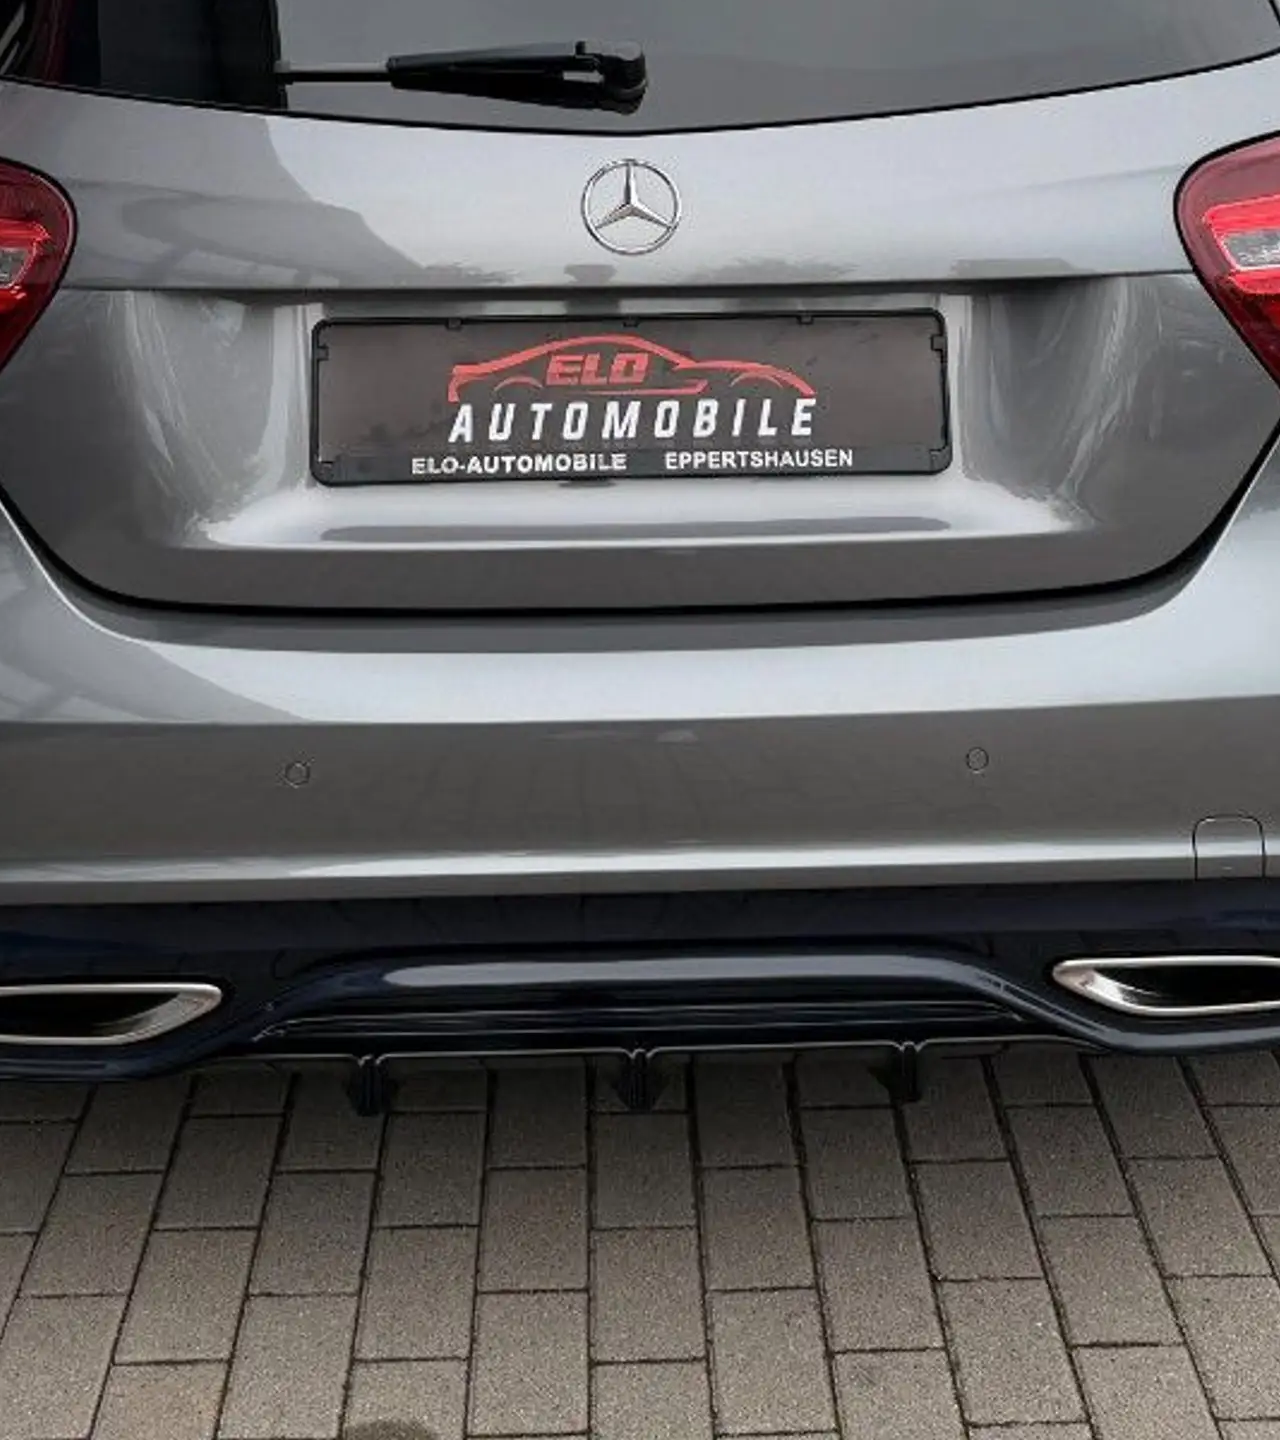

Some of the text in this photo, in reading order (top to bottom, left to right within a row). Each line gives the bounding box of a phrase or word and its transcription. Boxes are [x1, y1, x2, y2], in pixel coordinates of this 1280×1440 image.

[546, 353, 649, 385] ELO
[447, 398, 817, 444] AUTOMOBILE
[412, 449, 854, 475] ELO-AUTOMOBILE EPPERTSHAUSEN
